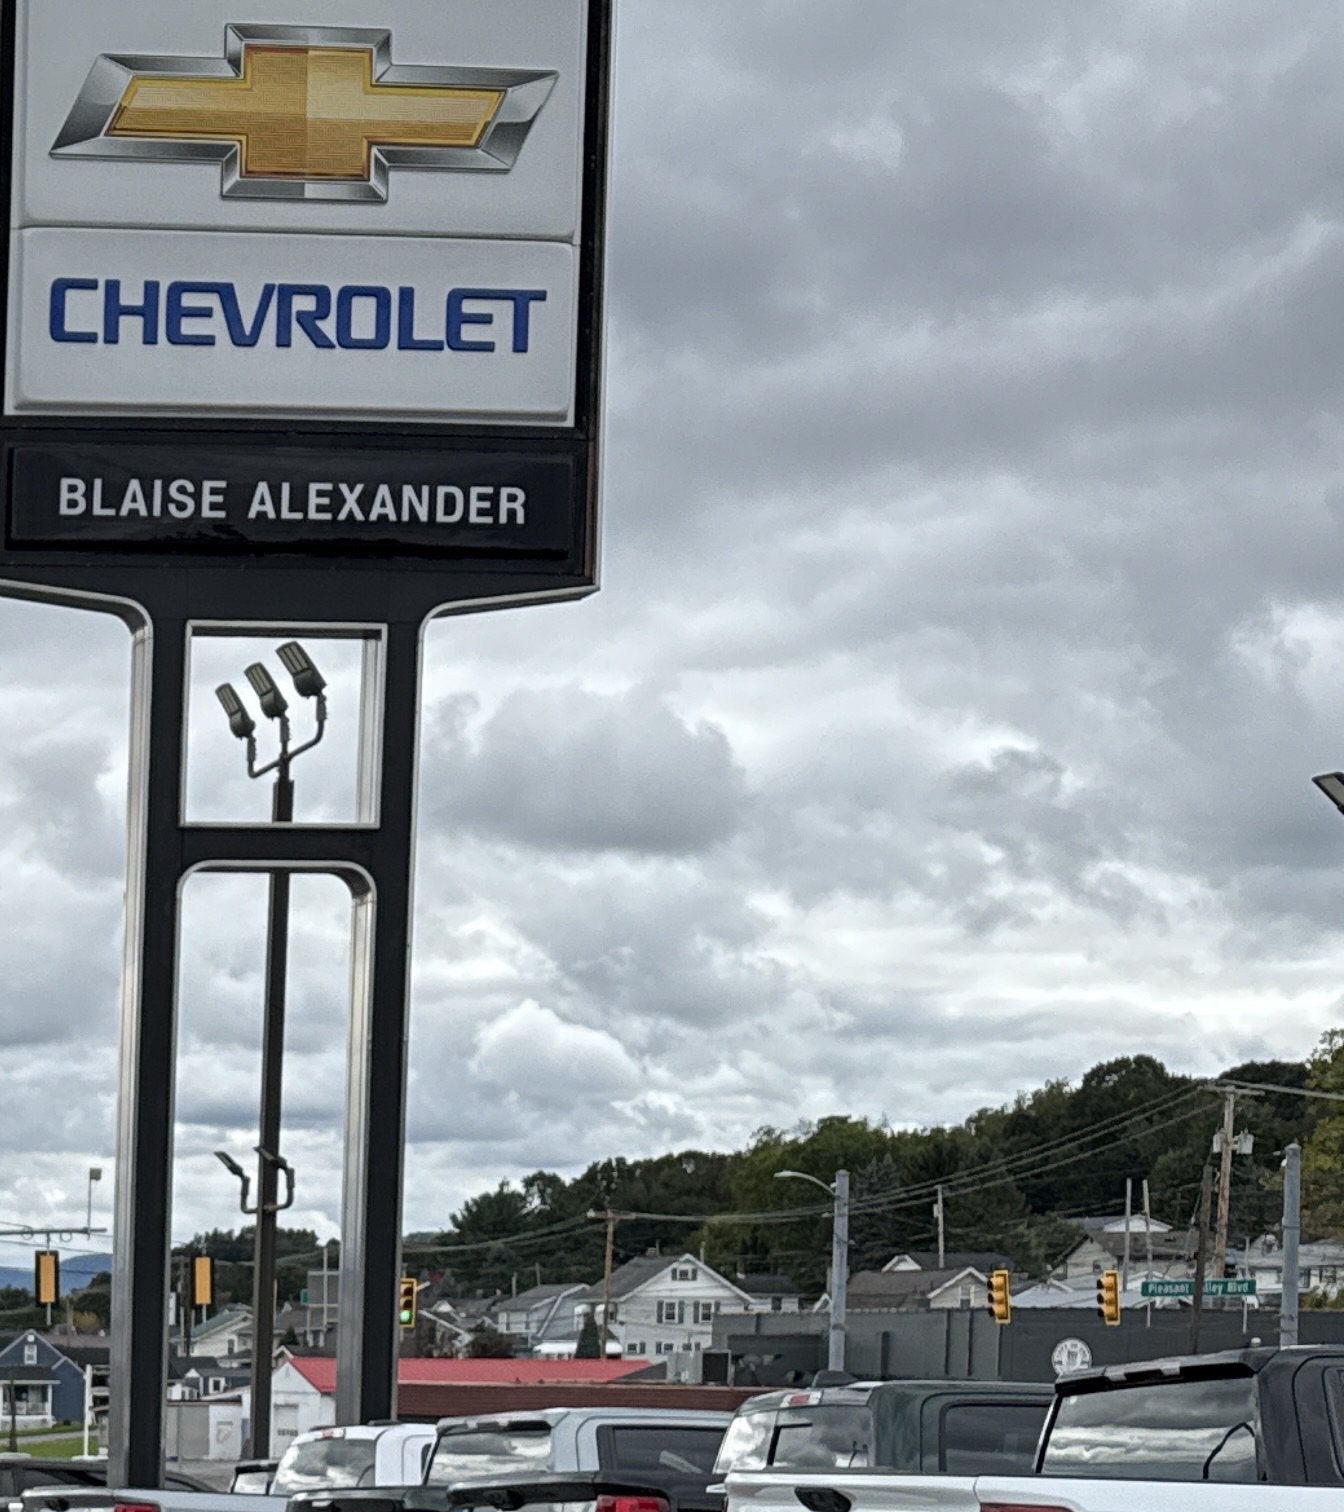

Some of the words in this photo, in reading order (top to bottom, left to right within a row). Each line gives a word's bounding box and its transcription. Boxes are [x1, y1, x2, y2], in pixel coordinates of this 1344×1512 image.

[49, 278, 547, 353] CHEVROLET
[58, 477, 228, 520] BLAISE
[247, 481, 527, 525] ALEXANDER
[1148, 1282, 1190, 1294] Pleasant
[1227, 1281, 1249, 1293] Blvd
